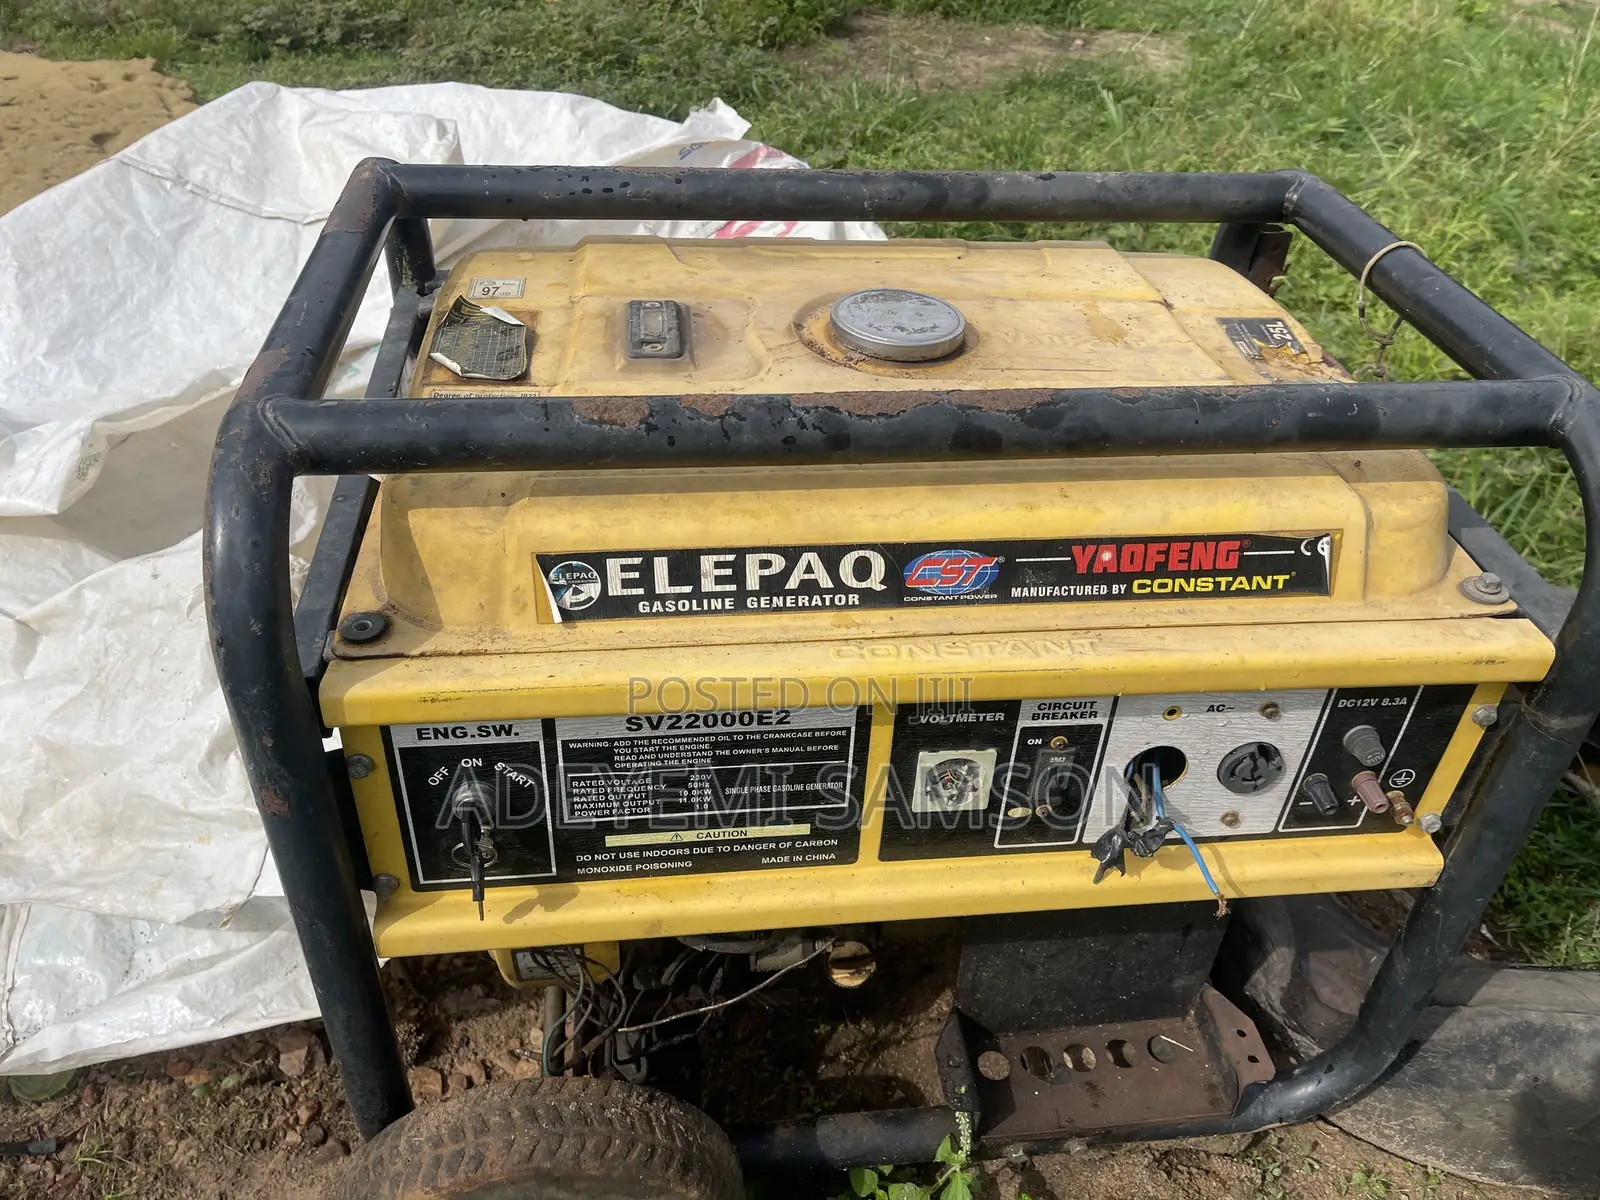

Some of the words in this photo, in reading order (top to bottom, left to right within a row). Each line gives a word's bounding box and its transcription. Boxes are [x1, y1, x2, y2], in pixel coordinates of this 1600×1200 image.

[482, 286, 500, 296] 97
[1266, 321, 1293, 341] 25L
[1072, 540, 1241, 574] YAOFENG
[553, 571, 597, 580] ELEPAQ
[606, 550, 888, 596] ELEPAQ
[905, 557, 997, 588] CST
[1132, 574, 1290, 594] CONSTANT
[1011, 584, 1108, 598] MANUFACTURED
[1112, 584, 1127, 595] BY
[638, 598, 735, 614] GASOLINE
[746, 594, 860, 609] GENERATOR
[829, 638, 1102, 662] CONSTANT
[1037, 701, 1097, 711] CIRCUIT
[1338, 699, 1378, 708] DC12V
[1381, 697, 1407, 706] 8.3A
[625, 710, 791, 732] SV22000E2
[920, 712, 1005, 724] VOLTMETER
[1031, 711, 1098, 721] BREAKER
[416, 724, 519, 740] ENG.SW.
[568, 741, 612, 749] WARNING:
[651, 733, 716, 745] RECOMMENDED
[762, 731, 813, 740] CRANKCASE
[633, 745, 660, 753] START
[680, 742, 713, 750] ENGINE.
[658, 750, 714, 759] UNDERSTAND
[732, 747, 770, 755] OWNER'S
[806, 744, 839, 752] BEFORE
[461, 758, 482, 767] ON
[614, 760, 662, 769] OPERATING
[681, 757, 715, 765] ENGINE.
[427, 766, 450, 786] OFF
[494, 762, 535, 789] START
[572, 780, 604, 788] RATED
[607, 777, 652, 786] VOLTAGE
[725, 786, 748, 795] SINGLE
[749, 785, 771, 793] PHASE
[772, 783, 805, 792] GASOLINE
[805, 781, 843, 790] GENERATOR
[573, 787, 605, 795] RATED
[607, 783, 667, 794] FREQUENCY
[679, 789, 712, 797] 10.0KW
[573, 795, 605, 803] RATED
[607, 792, 647, 801] OUTPUT
[678, 796, 712, 804] 11.0KW
[574, 801, 620, 810] MAXIMUM
[622, 798, 661, 806] OUTPUT
[574, 809, 610, 817] POWER
[612, 807, 651, 815] FACTOR
[696, 830, 748, 840] CAUTION
[594, 852, 616, 861] NOT
[619, 851, 640, 859] USE
[643, 847, 690, 858] INDOORS
[693, 847, 714, 855] DUE
[717, 845, 731, 853] TO
[733, 843, 776, 852] DANGER
[795, 839, 838, 848] CARBON
[761, 855, 791, 864] MADE
[805, 853, 836, 861] CHINA
[577, 865, 633, 875] MONOXIDE
[635, 860, 693, 871] POISONING
